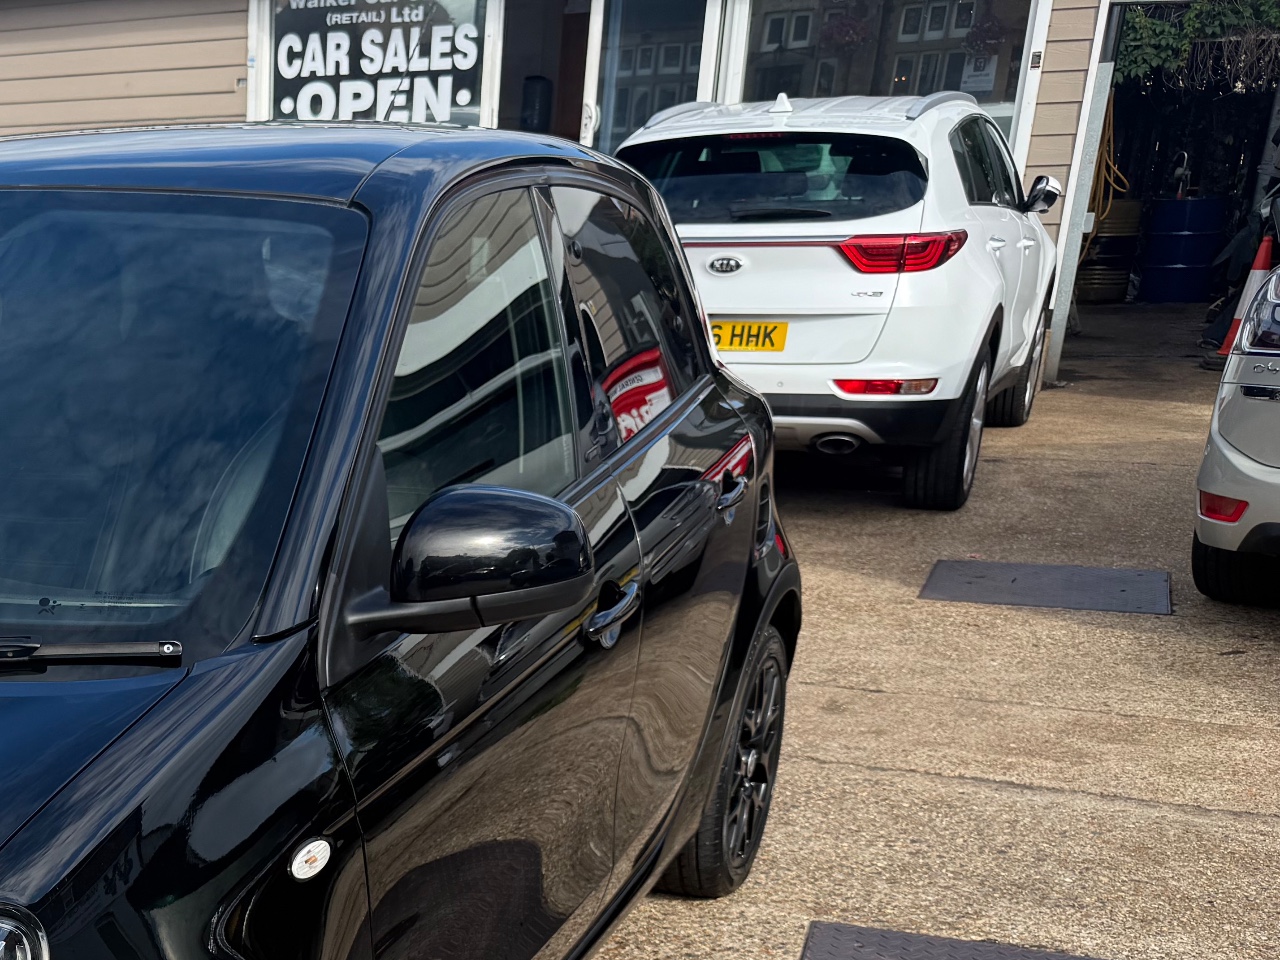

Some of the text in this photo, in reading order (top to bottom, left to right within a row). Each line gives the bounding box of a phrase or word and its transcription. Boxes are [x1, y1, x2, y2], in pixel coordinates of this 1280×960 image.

[325, 5, 426, 27] (RETAIL) Ltd
[277, 23, 479, 79] CAR SALES
[713, 258, 738, 272] KIA
[729, 325, 778, 348] HHK
